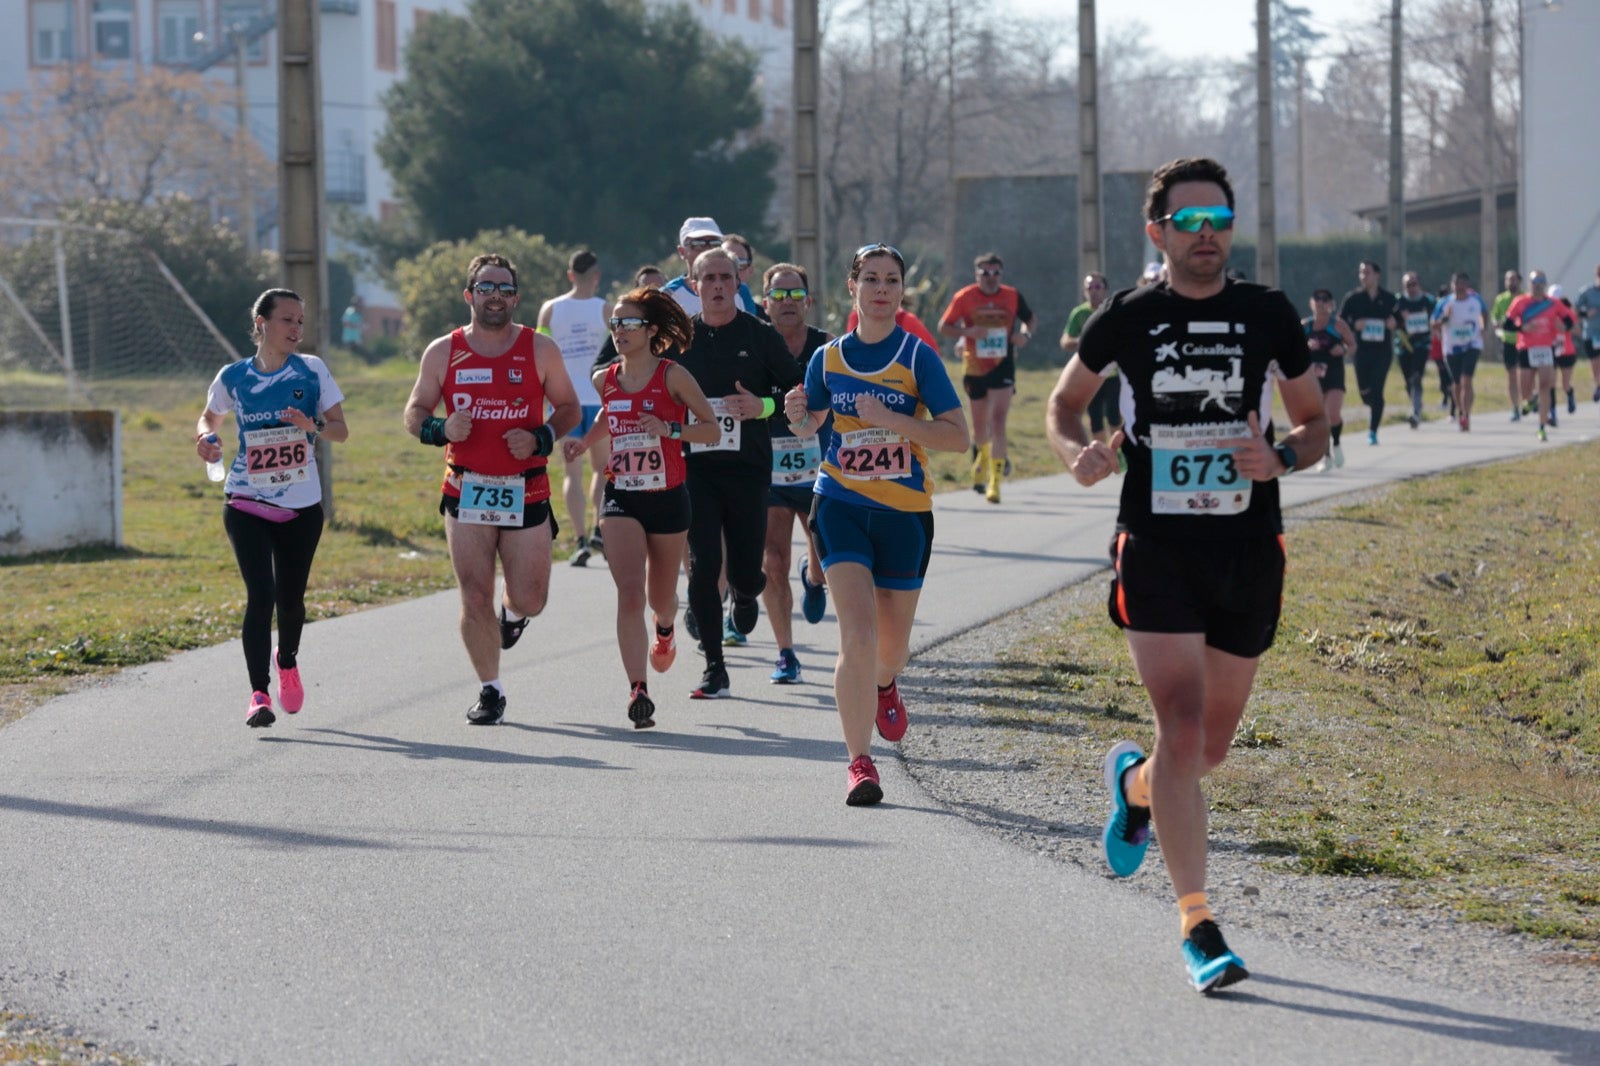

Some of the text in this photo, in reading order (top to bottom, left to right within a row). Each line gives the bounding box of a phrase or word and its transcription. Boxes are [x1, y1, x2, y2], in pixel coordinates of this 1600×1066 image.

[1181, 342, 1244, 356] CaixaBank
[452, 393, 529, 420] Plisalud
[832, 389, 905, 405] aguinos
[250, 443, 305, 470] 2256
[612, 450, 662, 473] 2179
[780, 452, 806, 470] 45
[842, 446, 905, 472] 2241
[1170, 453, 1238, 486] 673
[472, 486, 514, 508] 735
